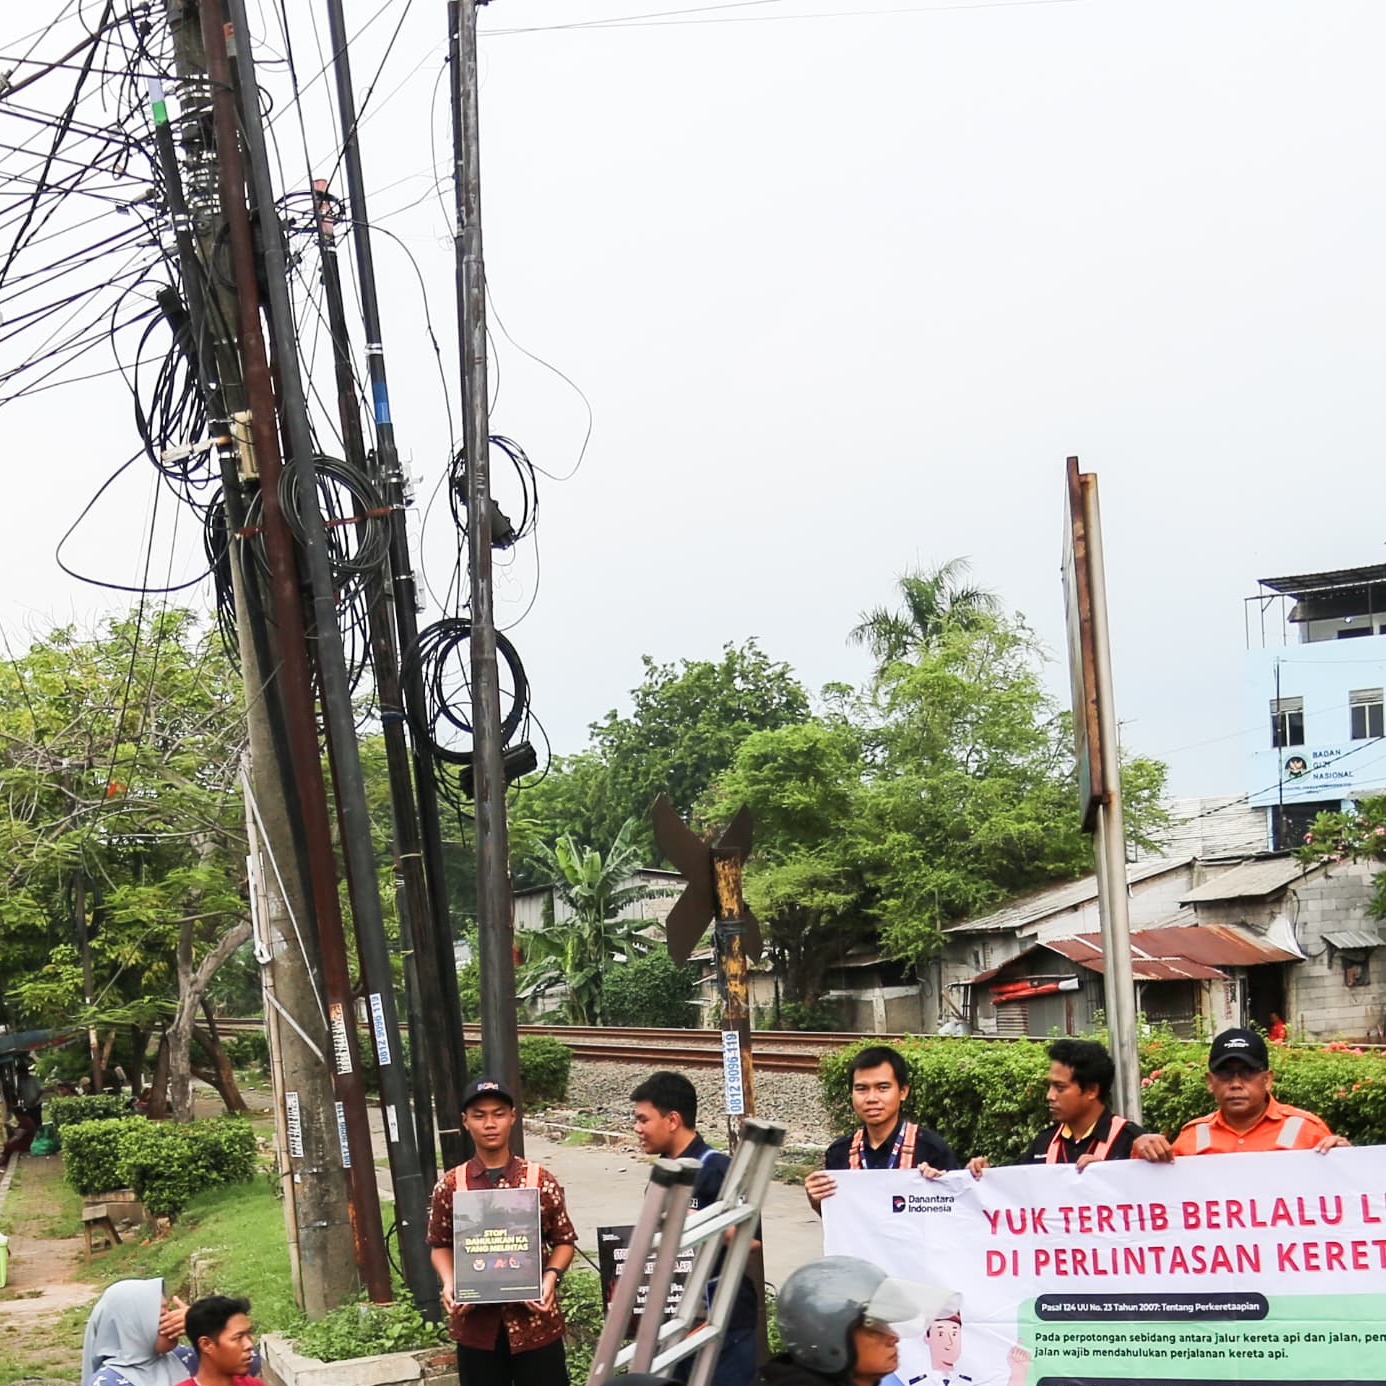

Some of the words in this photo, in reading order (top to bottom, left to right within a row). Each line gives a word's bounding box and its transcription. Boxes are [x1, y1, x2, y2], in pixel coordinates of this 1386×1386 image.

[1313, 770, 1354, 780] NASIONAL
[725, 1033, 738, 1053] 119
[727, 1056, 740, 1083] 9096
[729, 1085, 742, 1112] 0812
[908, 1194, 955, 1204] Danantara
[908, 1203, 953, 1213] Indonesia
[983, 1207, 1048, 1236] YUK
[1059, 1203, 1169, 1235] TERTIB
[1182, 1195, 1343, 1231] BERLALU
[465, 1245, 489, 1254] YANG
[490, 1243, 529, 1253] MELINTAS
[986, 1249, 1019, 1278] DI
[1034, 1243, 1261, 1277] PERLINTASAN
[1041, 1302, 1062, 1312] Pasal
[1063, 1302, 1077, 1312] 124
[1077, 1302, 1089, 1312] UU
[1089, 1302, 1103, 1312] No.
[1103, 1302, 1113, 1312] 23
[1114, 1302, 1139, 1312] Tahun
[1139, 1302, 1161, 1312] 2007:
[1162, 1302, 1194, 1314] Tentang
[1195, 1301, 1260, 1313] Perkeretaapian
[1035, 1332, 1061, 1343] Pada
[1063, 1333, 1127, 1345] perpotongan
[1129, 1332, 1176, 1344] sebidang
[1179, 1334, 1213, 1343] antara
[1214, 1332, 1241, 1344] jalur
[1243, 1332, 1280, 1343] kereta
[1282, 1332, 1300, 1344] api
[1303, 1332, 1326, 1343] dan
[1328, 1331, 1362, 1344] jalan,
[1034, 1346, 1060, 1358] jalan
[1063, 1347, 1090, 1359] wajib
[1092, 1347, 1168, 1358] mendahulukan
[1170, 1348, 1226, 1360] perjalanan
[1228, 1348, 1266, 1359] kereta
[1268, 1348, 1289, 1360] api.
